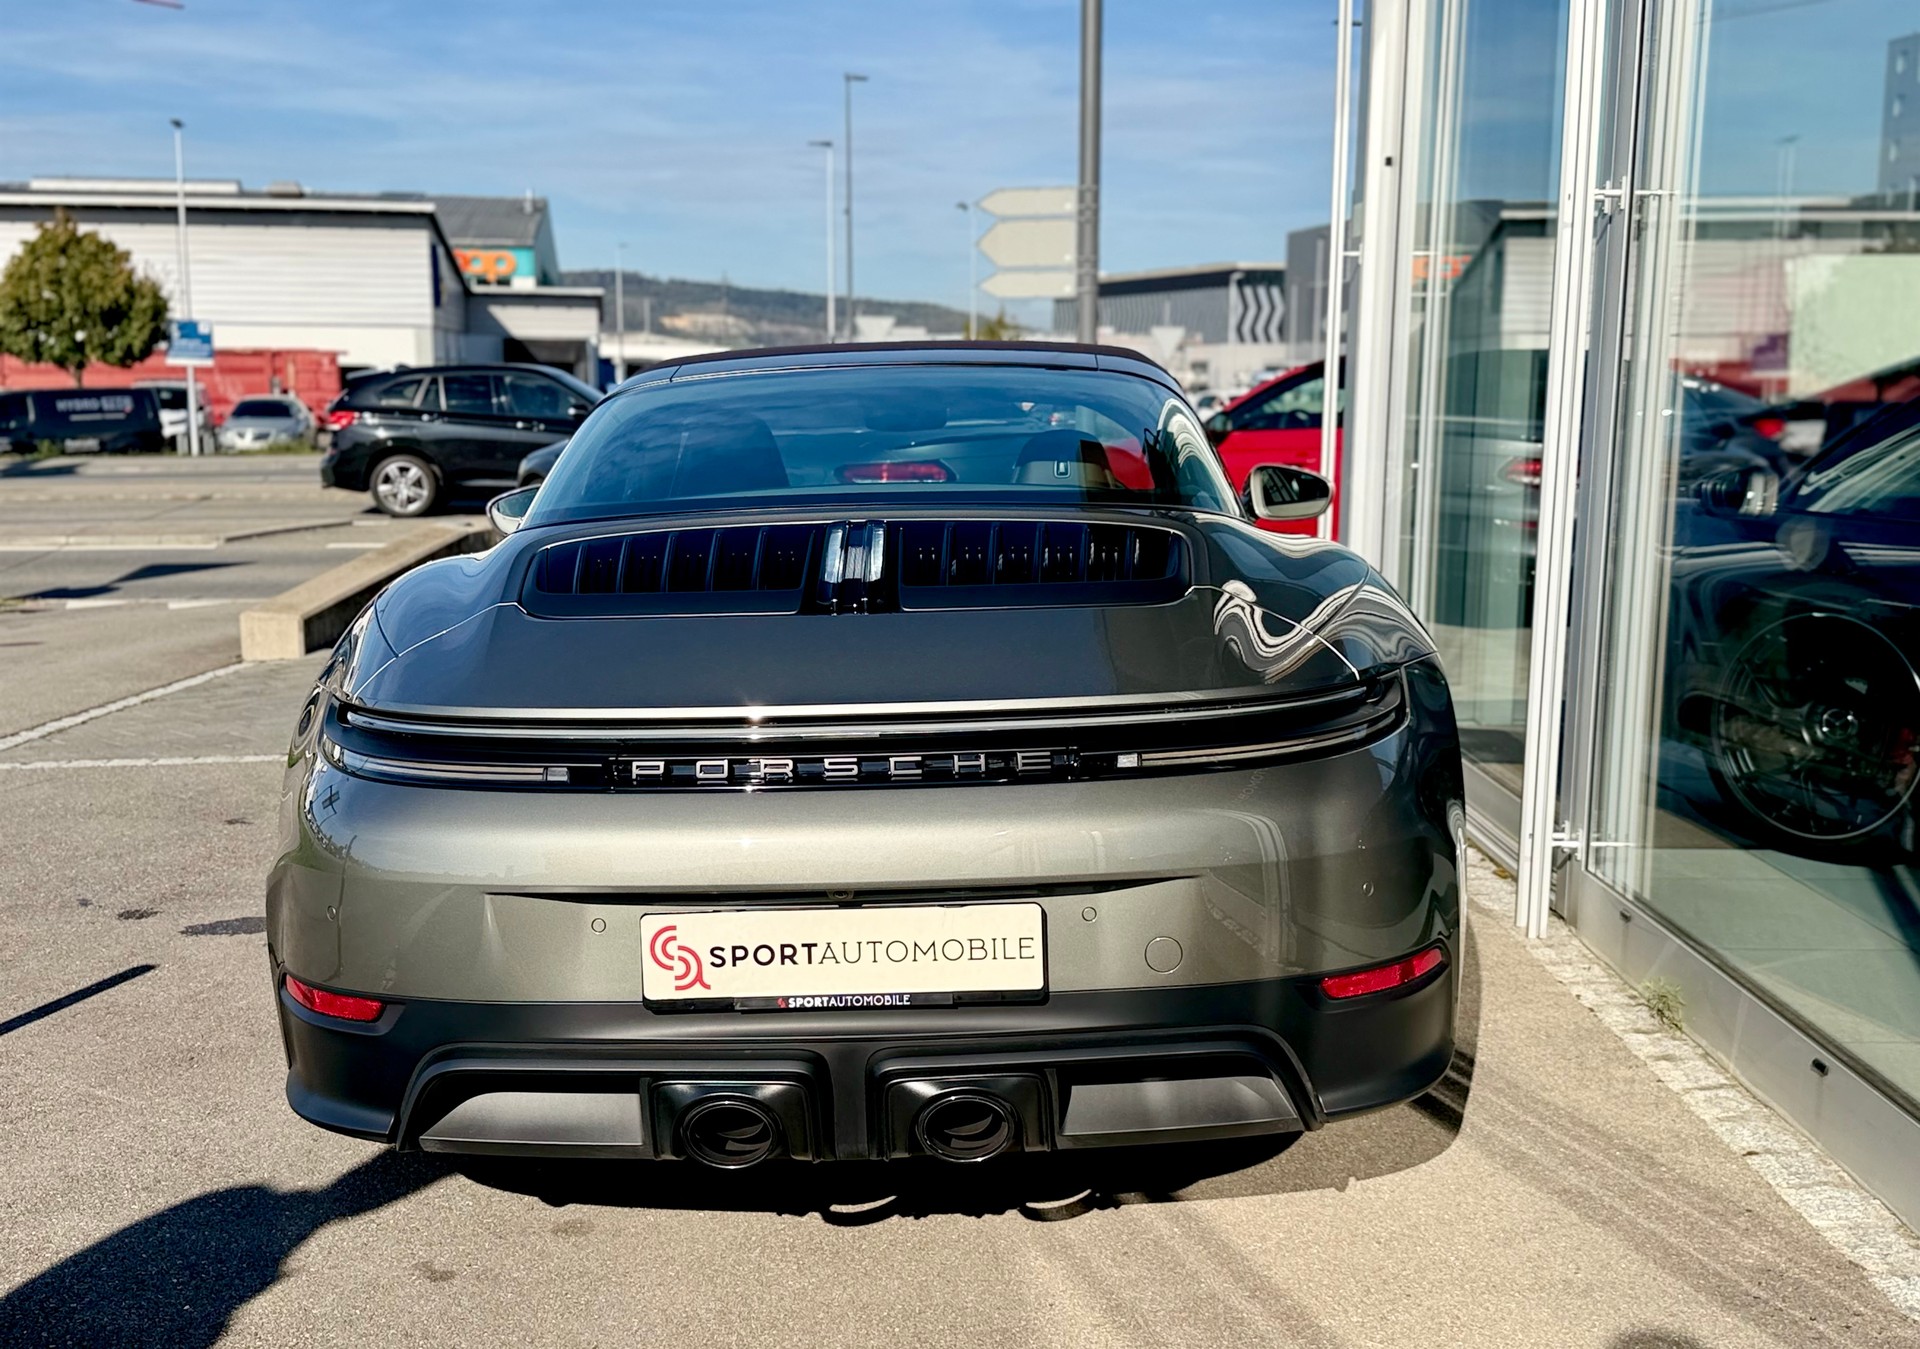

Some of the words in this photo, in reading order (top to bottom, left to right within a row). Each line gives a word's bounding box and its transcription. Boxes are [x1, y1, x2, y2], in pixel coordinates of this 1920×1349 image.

[632, 752, 1051, 780] PORSCHE
[709, 937, 1035, 968] SPORTAUTOMOBILE
[788, 994, 911, 1009] SPORTAUTOMOBILE
